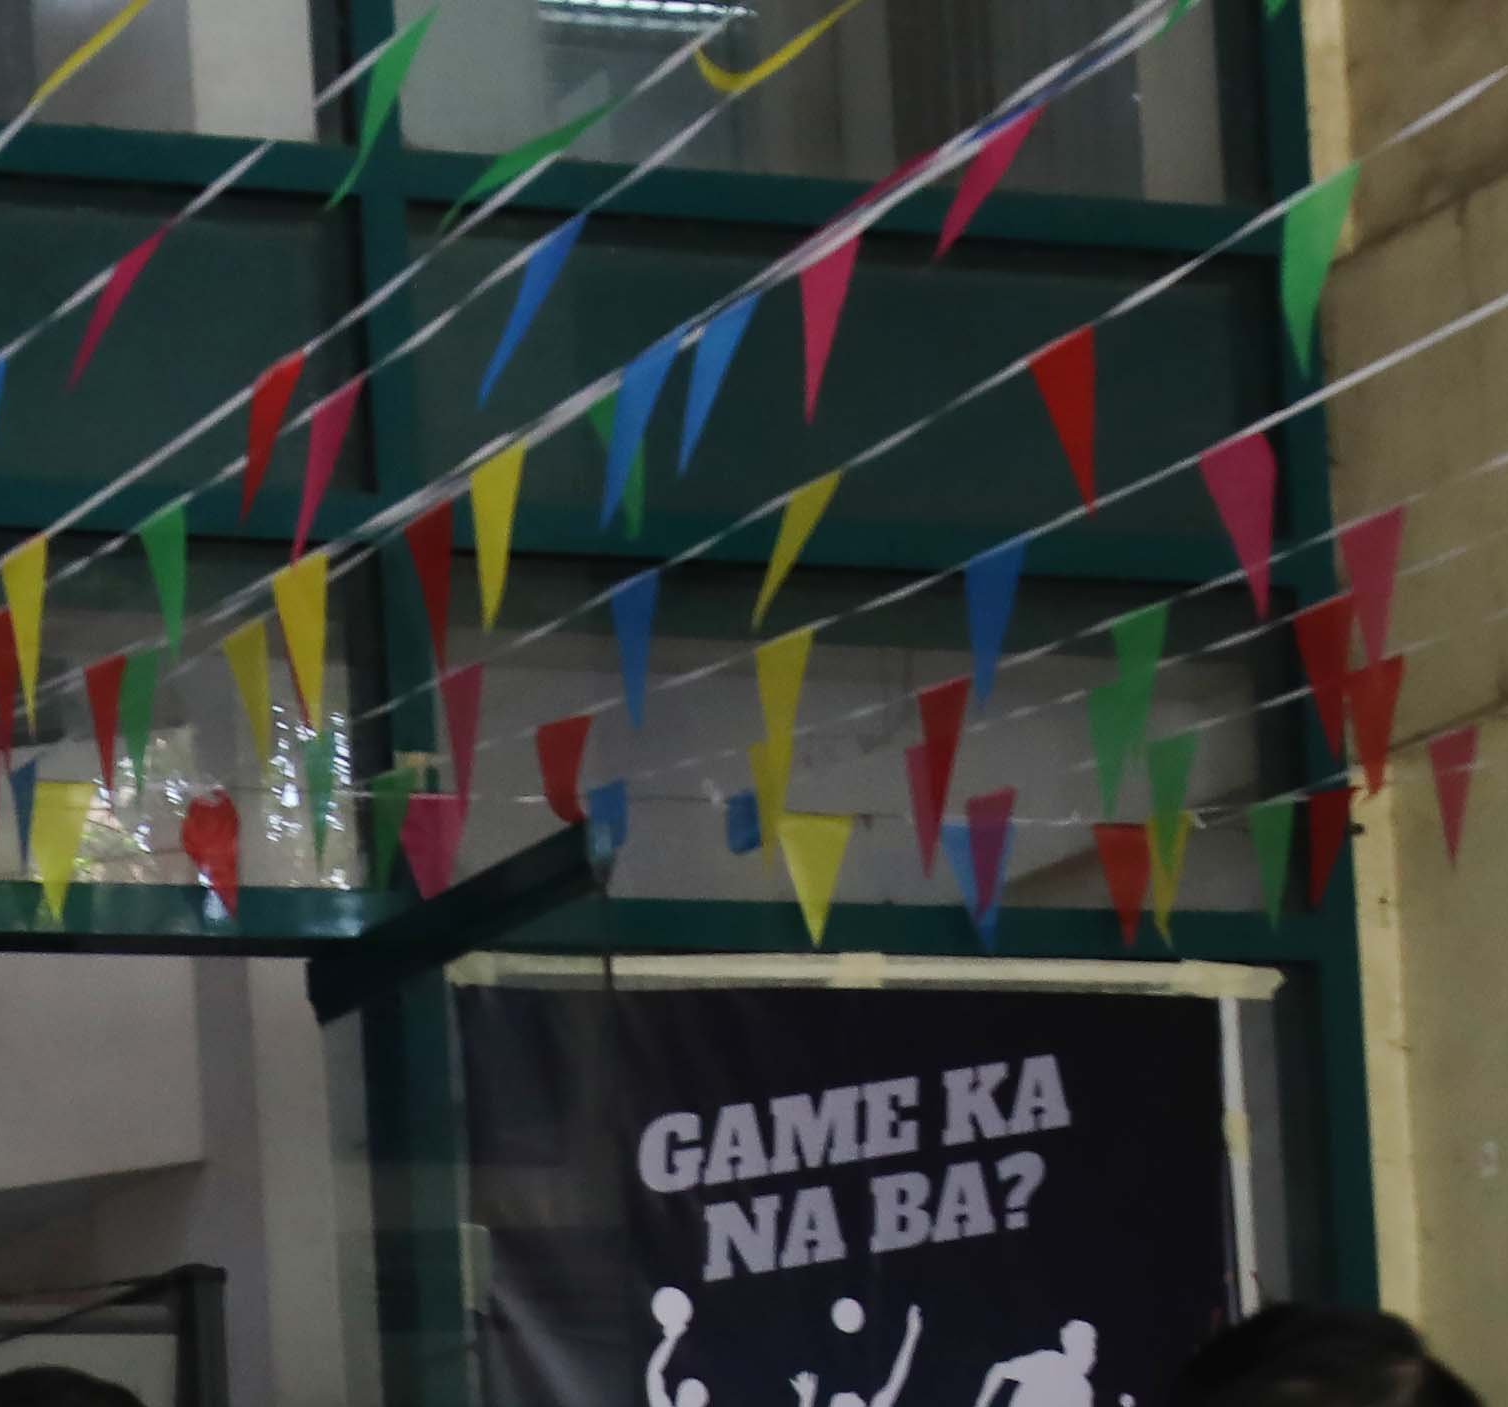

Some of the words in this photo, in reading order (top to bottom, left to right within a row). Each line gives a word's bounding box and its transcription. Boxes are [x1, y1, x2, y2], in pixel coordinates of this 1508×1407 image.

[637, 1076, 922, 1195] GAME
[942, 1053, 1072, 1148] KA
[702, 1184, 847, 1283] NA
[869, 1151, 1047, 1255] BA?
